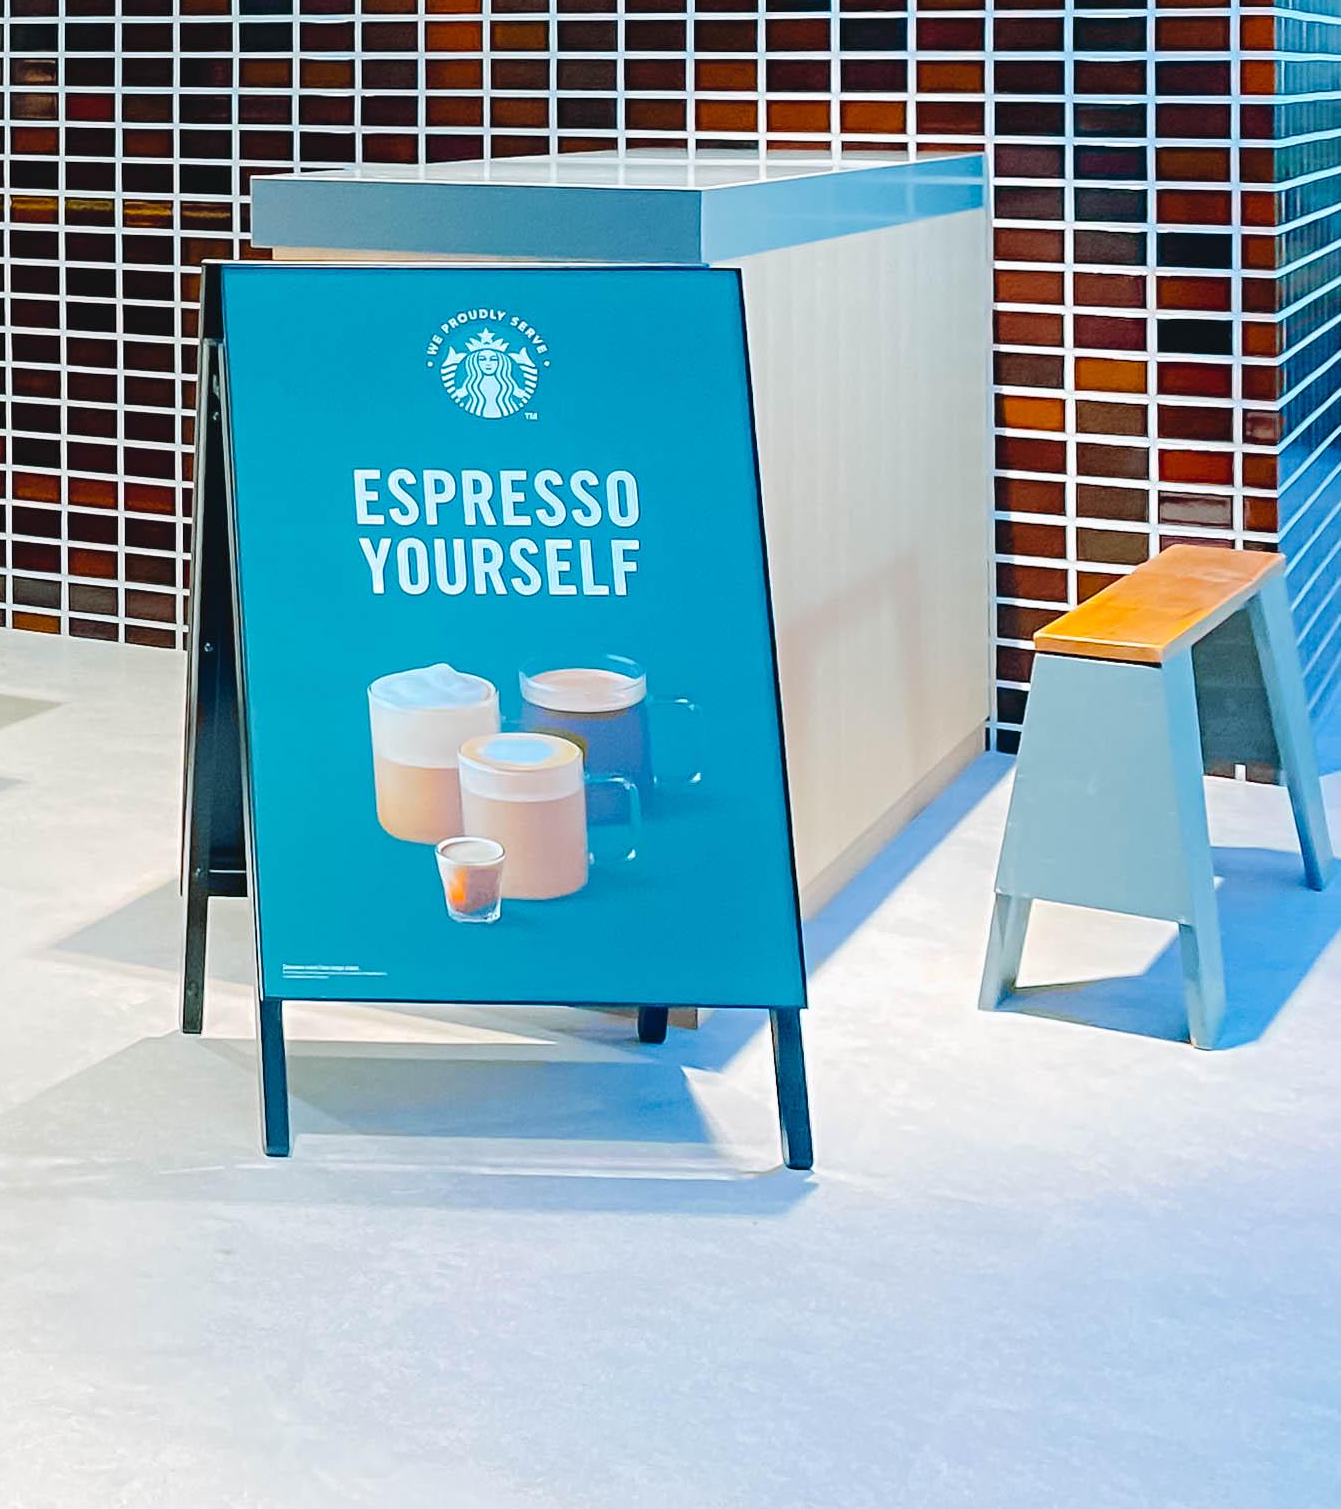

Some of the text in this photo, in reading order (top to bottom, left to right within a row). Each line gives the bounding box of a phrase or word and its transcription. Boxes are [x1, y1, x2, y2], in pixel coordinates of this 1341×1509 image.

[426, 308, 549, 356] WE PROUDLY SERVE
[353, 468, 640, 527] ESPRESSO
[358, 537, 640, 596] YOURSELF
